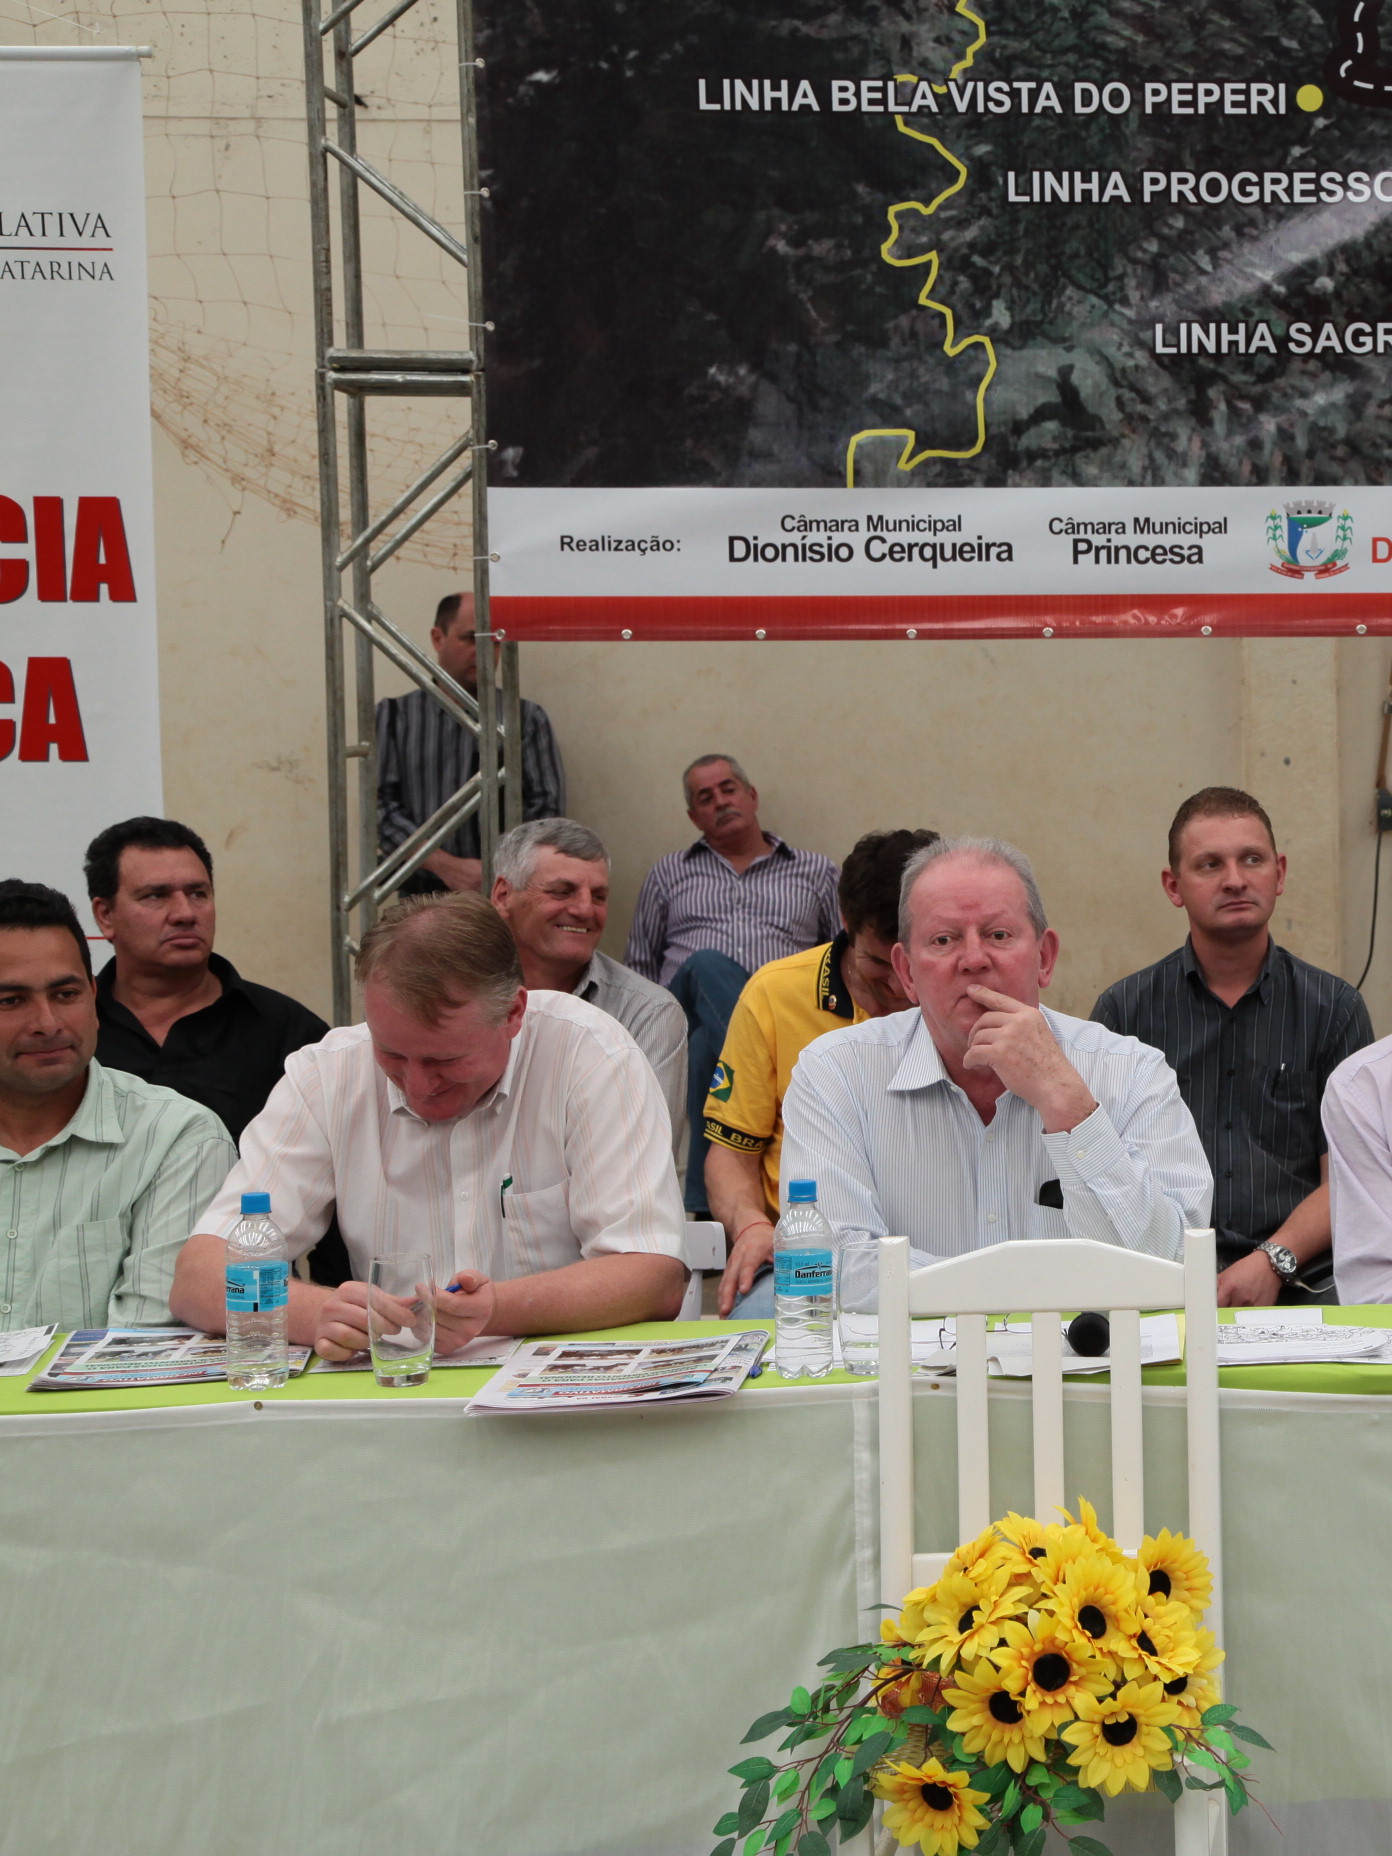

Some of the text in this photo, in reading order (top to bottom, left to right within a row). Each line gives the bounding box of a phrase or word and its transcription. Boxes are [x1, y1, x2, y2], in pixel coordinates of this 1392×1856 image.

[698, 79, 1287, 115] LINHA BELA VISTA DO PEPERI
[1007, 171, 1131, 203] LINHA
[0, 211, 112, 238] LATIVA
[0, 260, 115, 281] ATARINA
[1154, 323, 1278, 354] LINHA
[780, 514, 962, 537] Câmara Municipal
[1048, 516, 1228, 539] Câmara Municipal
[559, 535, 682, 556] Realização:
[727, 535, 1014, 569] Dionísio Cerqueira
[1072, 538, 1204, 565] Princesa
